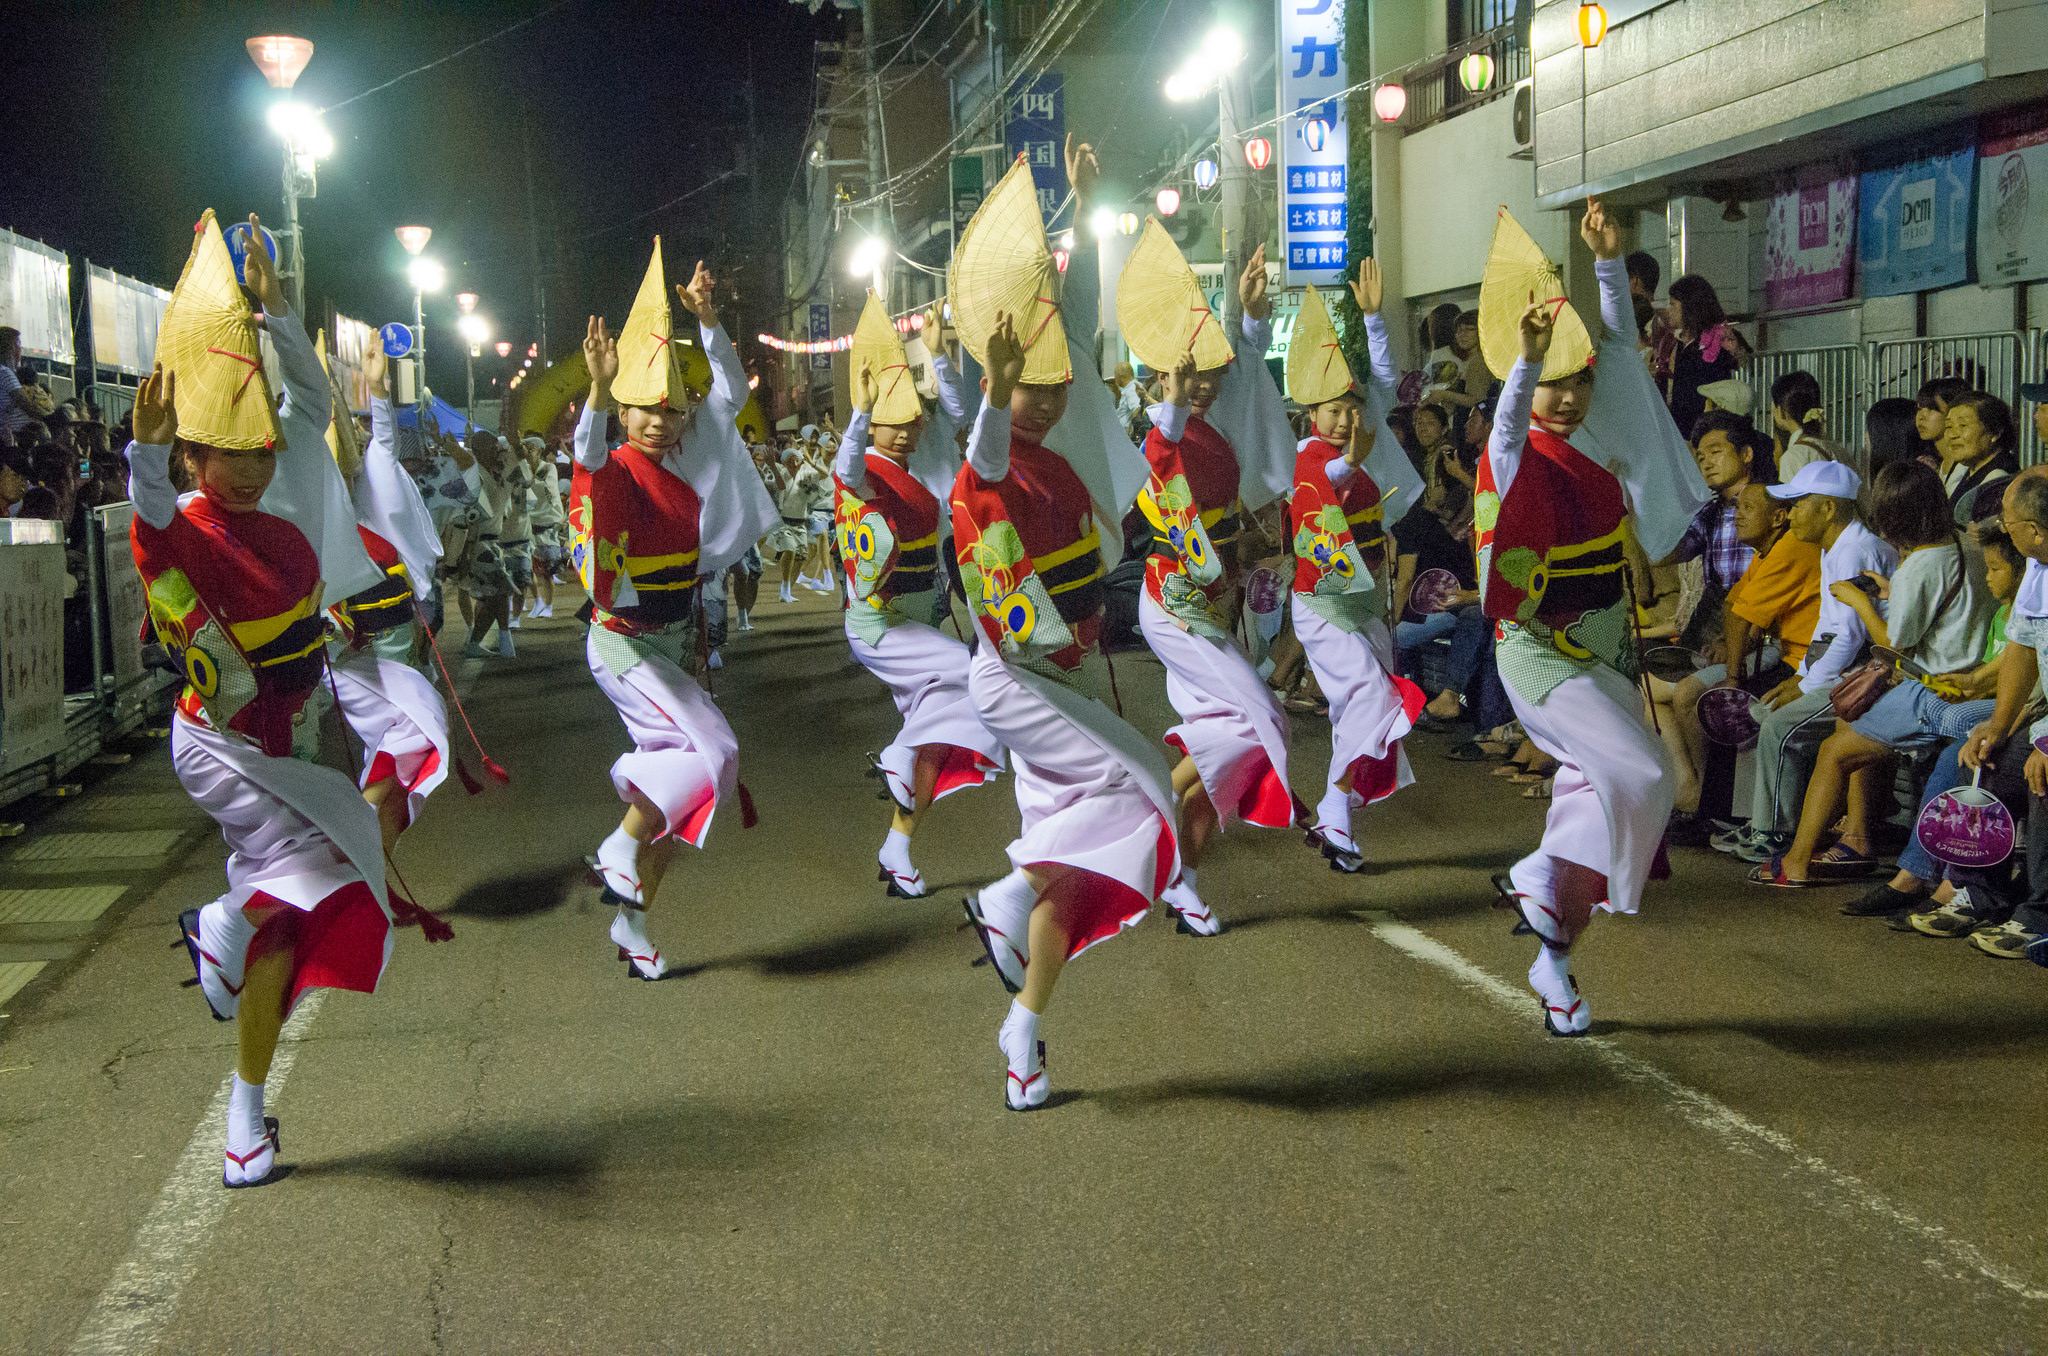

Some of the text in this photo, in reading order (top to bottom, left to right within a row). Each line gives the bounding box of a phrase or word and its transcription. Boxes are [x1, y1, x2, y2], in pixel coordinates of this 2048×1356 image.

[1292, 170, 1342, 188] 金物建材
[1292, 209, 1342, 226] 土木資材
[1902, 198, 1931, 226] DCM
[1292, 247, 1343, 264] 配管資材
